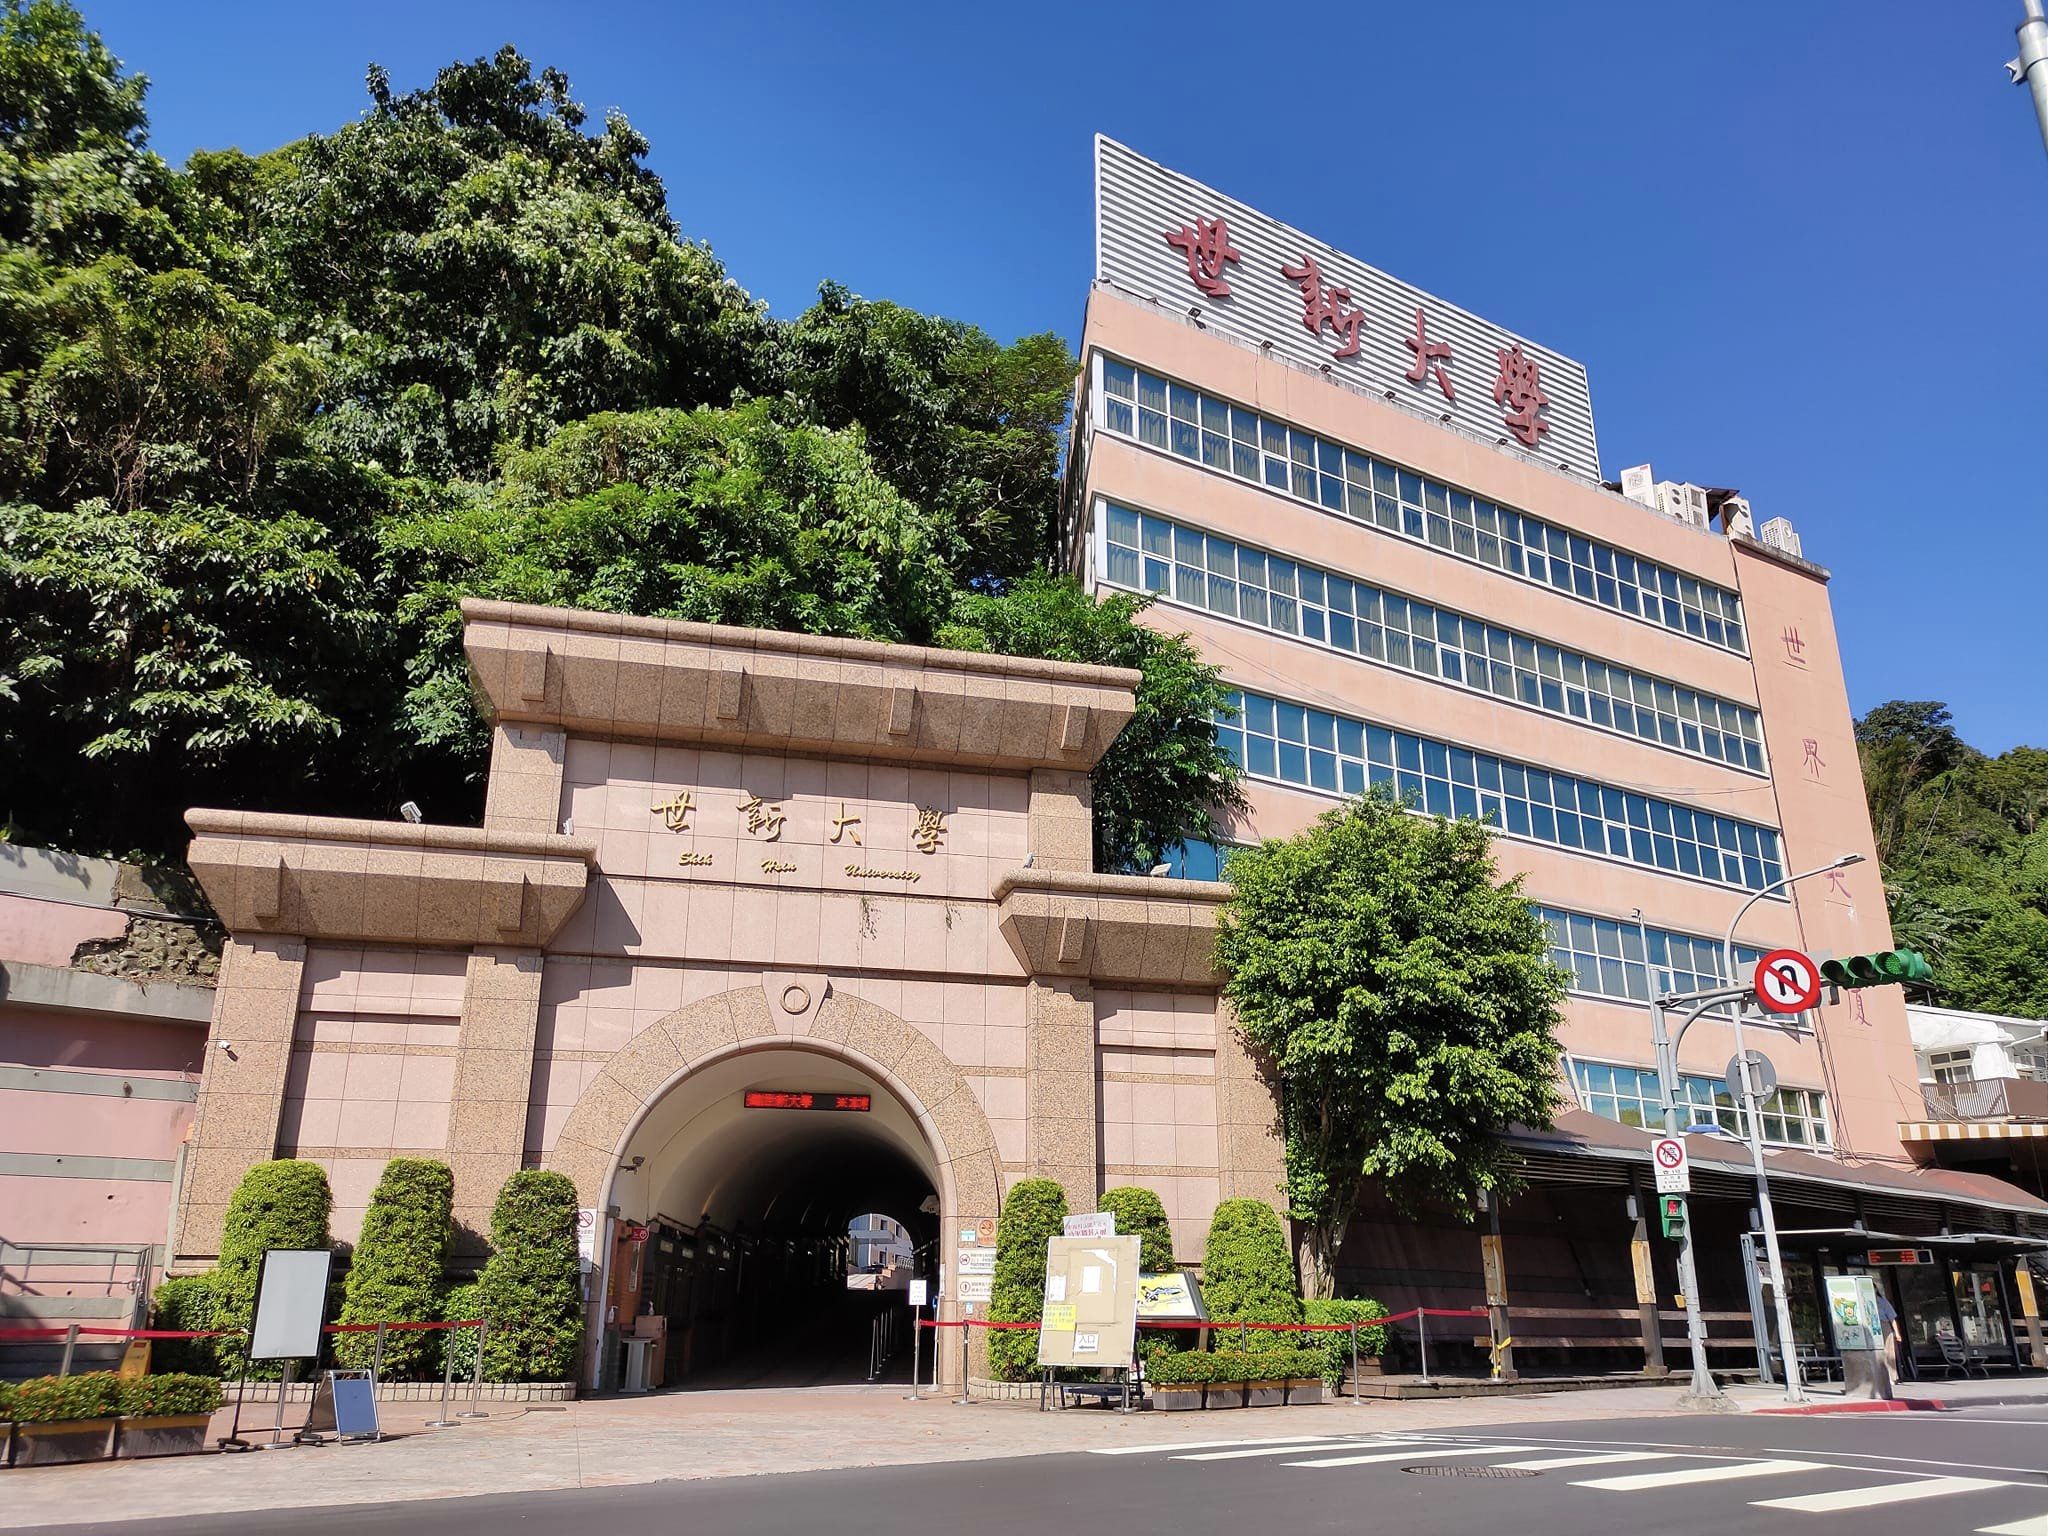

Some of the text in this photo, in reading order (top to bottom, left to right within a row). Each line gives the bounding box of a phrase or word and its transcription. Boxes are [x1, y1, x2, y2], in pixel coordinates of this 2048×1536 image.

[1163, 216, 1549, 445] 世新大學
[650, 789, 948, 855] 世新大學
[679, 852, 922, 883] Shih Hsin University
[1078, 1335, 1096, 1344] 入口
